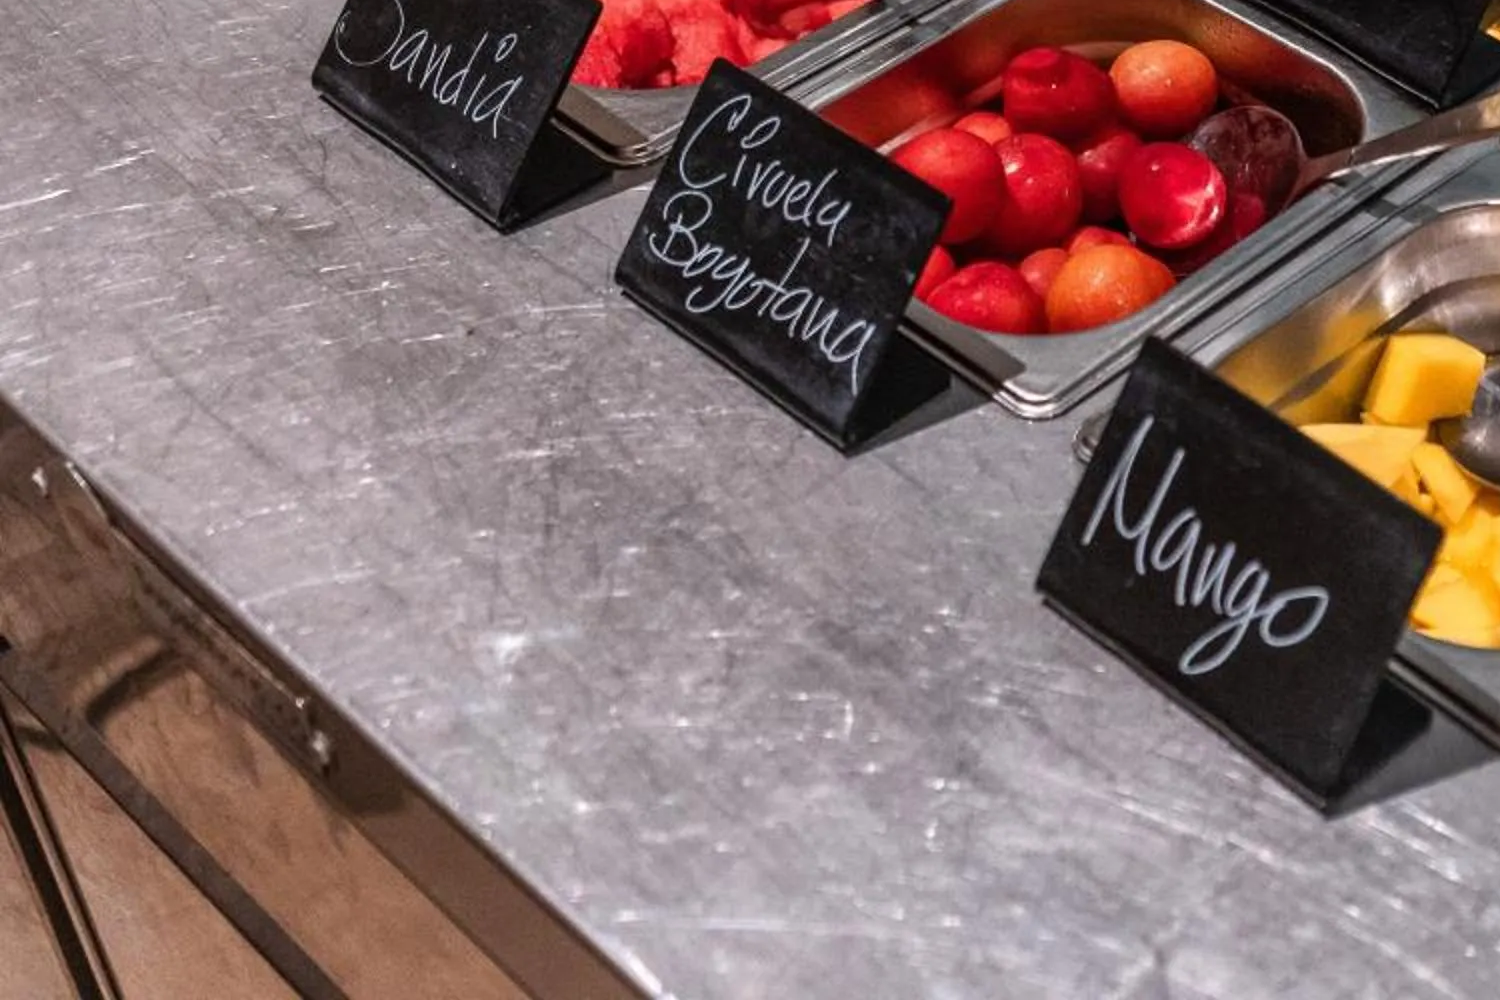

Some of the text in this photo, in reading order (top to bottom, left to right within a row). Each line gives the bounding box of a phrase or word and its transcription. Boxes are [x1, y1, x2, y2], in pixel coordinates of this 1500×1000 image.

[679, 94, 852, 247] Ciruela
[649, 191, 876, 396] Bogotana
[1082, 415, 1329, 676] Mango
